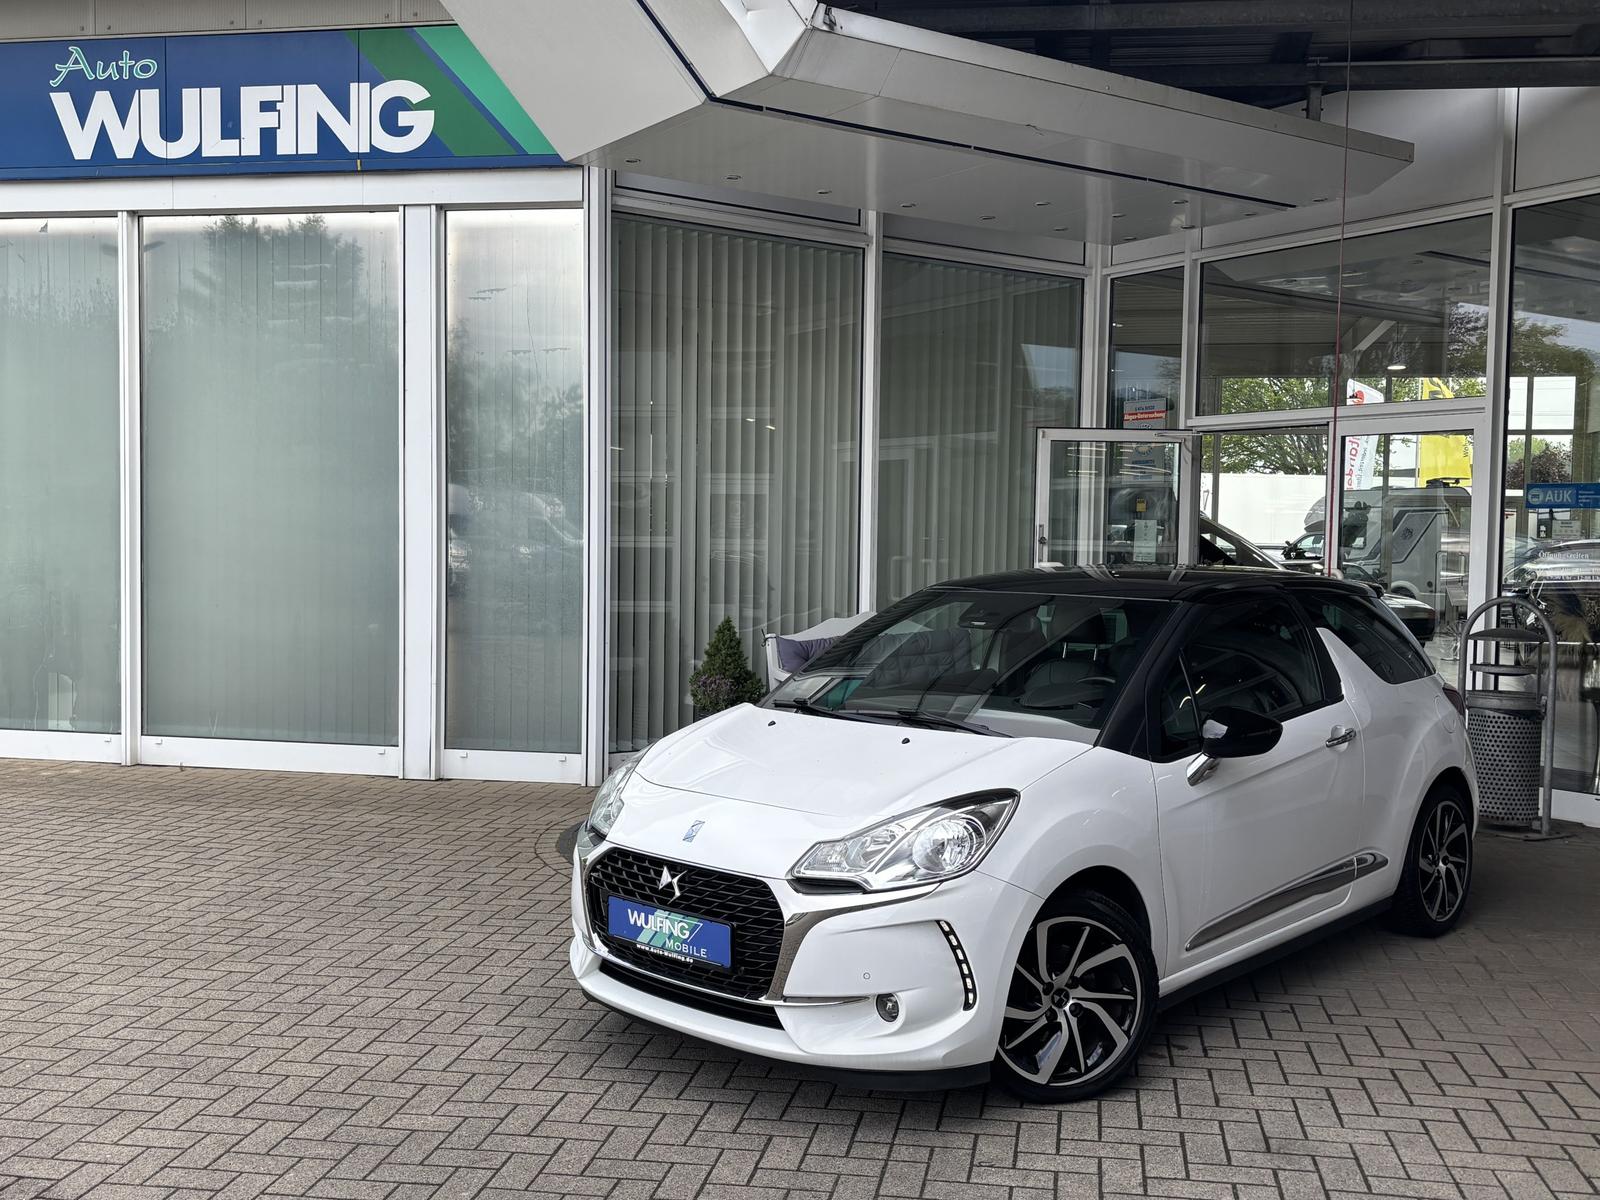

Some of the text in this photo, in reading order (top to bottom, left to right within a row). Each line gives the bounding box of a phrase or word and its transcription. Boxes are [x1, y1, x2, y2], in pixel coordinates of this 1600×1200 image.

[49, 45, 158, 88] Auto
[49, 79, 435, 161] WULFING
[1545, 490, 1572, 503] AUK
[627, 908, 690, 939] WULFING
[665, 938, 708, 958] MOBILE
